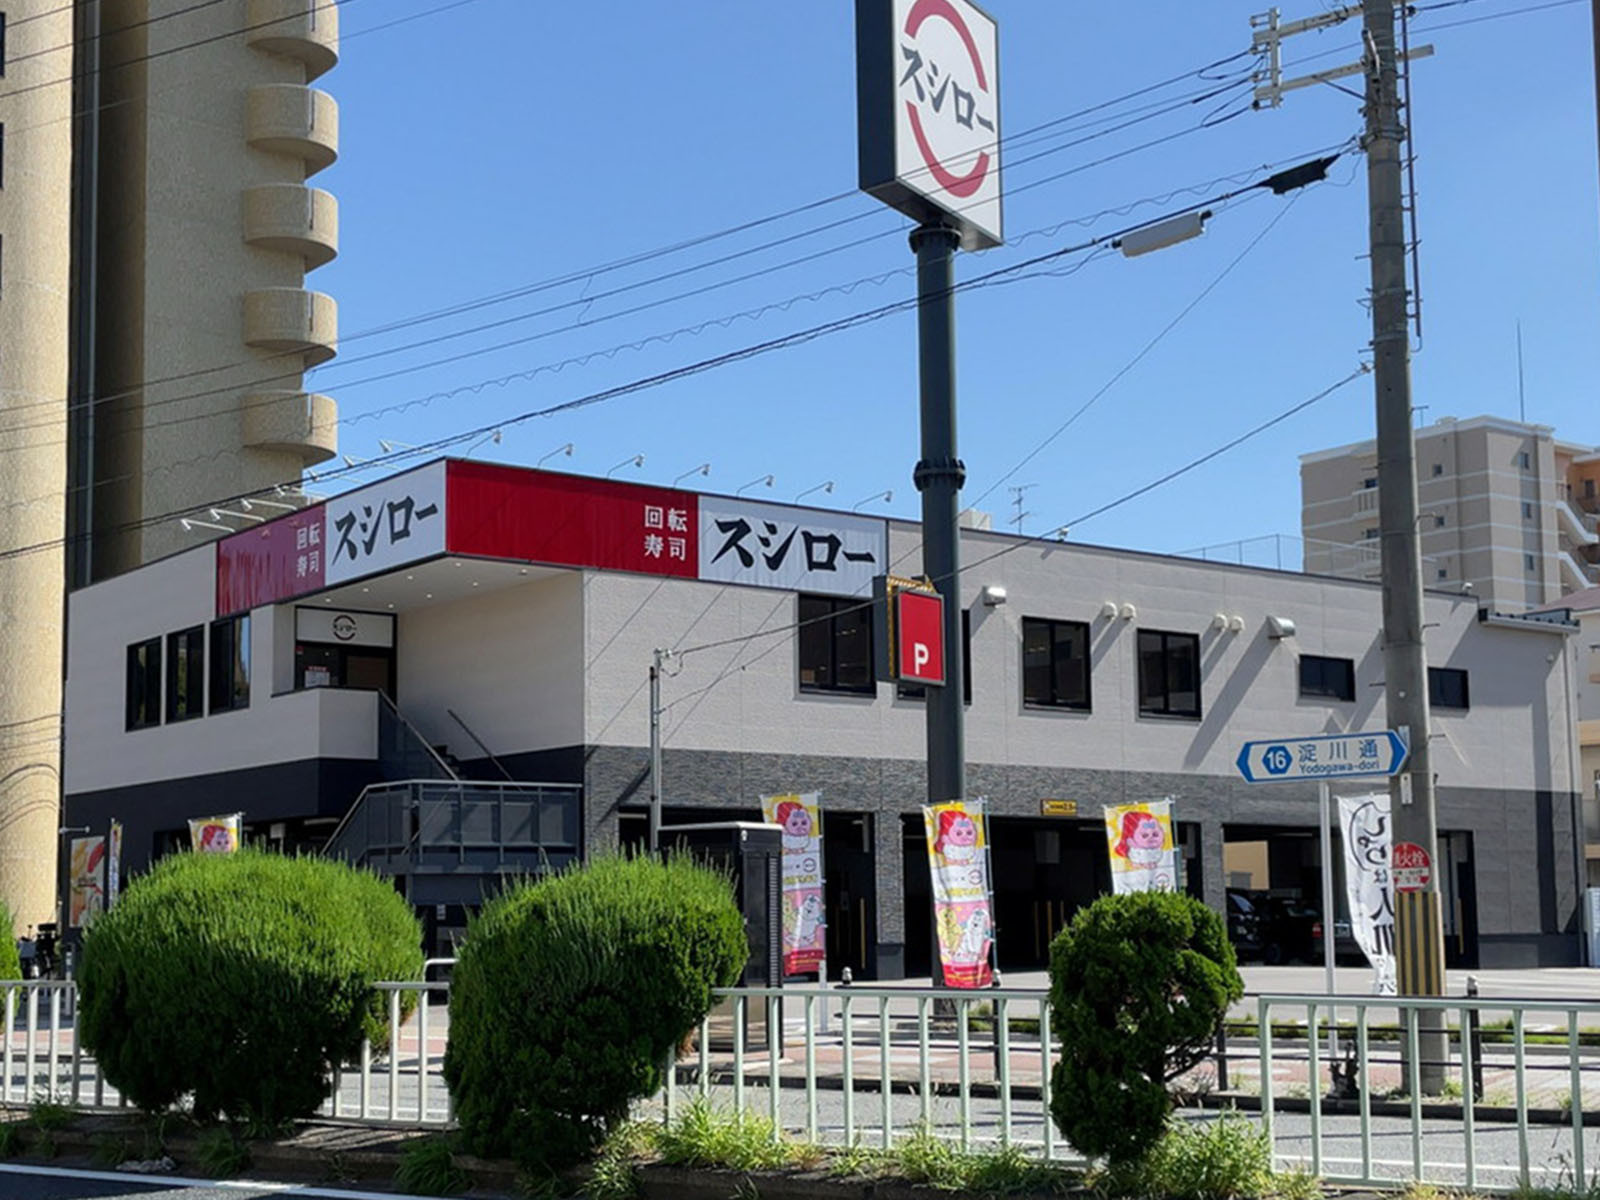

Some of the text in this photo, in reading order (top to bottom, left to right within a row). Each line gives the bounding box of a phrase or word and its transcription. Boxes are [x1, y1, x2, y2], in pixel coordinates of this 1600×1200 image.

[899, 42, 995, 133] スシロー
[332, 495, 438, 566] スシロー
[644, 505, 688, 532] 回転
[296, 522, 321, 550] 回転
[644, 533, 687, 562] 寿司
[711, 517, 876, 572] スシロー
[296, 550, 320, 578] 寿司
[914, 642, 929, 676] P
[1267, 750, 1287, 770] 16
[1298, 739, 1379, 763] 淀川通
[1299, 761, 1380, 775] Yodogawa-dori
